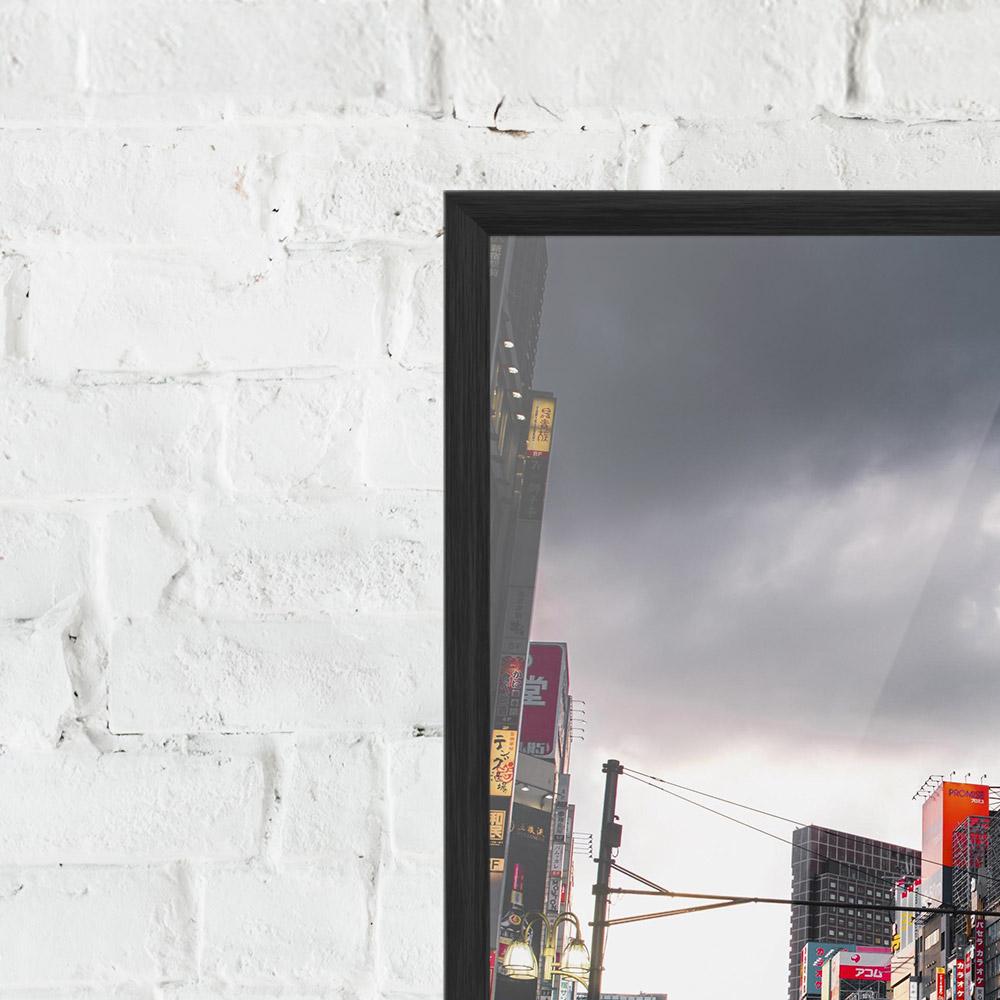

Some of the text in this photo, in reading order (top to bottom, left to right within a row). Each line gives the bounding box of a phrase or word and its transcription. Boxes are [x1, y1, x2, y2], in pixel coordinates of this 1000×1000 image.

[948, 788, 985, 799] PROMISE
[976, 921, 984, 945] パセラ
[855, 967, 884, 978] アコム
[957, 962, 965, 997] カラオケ
[976, 951, 984, 985] カラオケ
